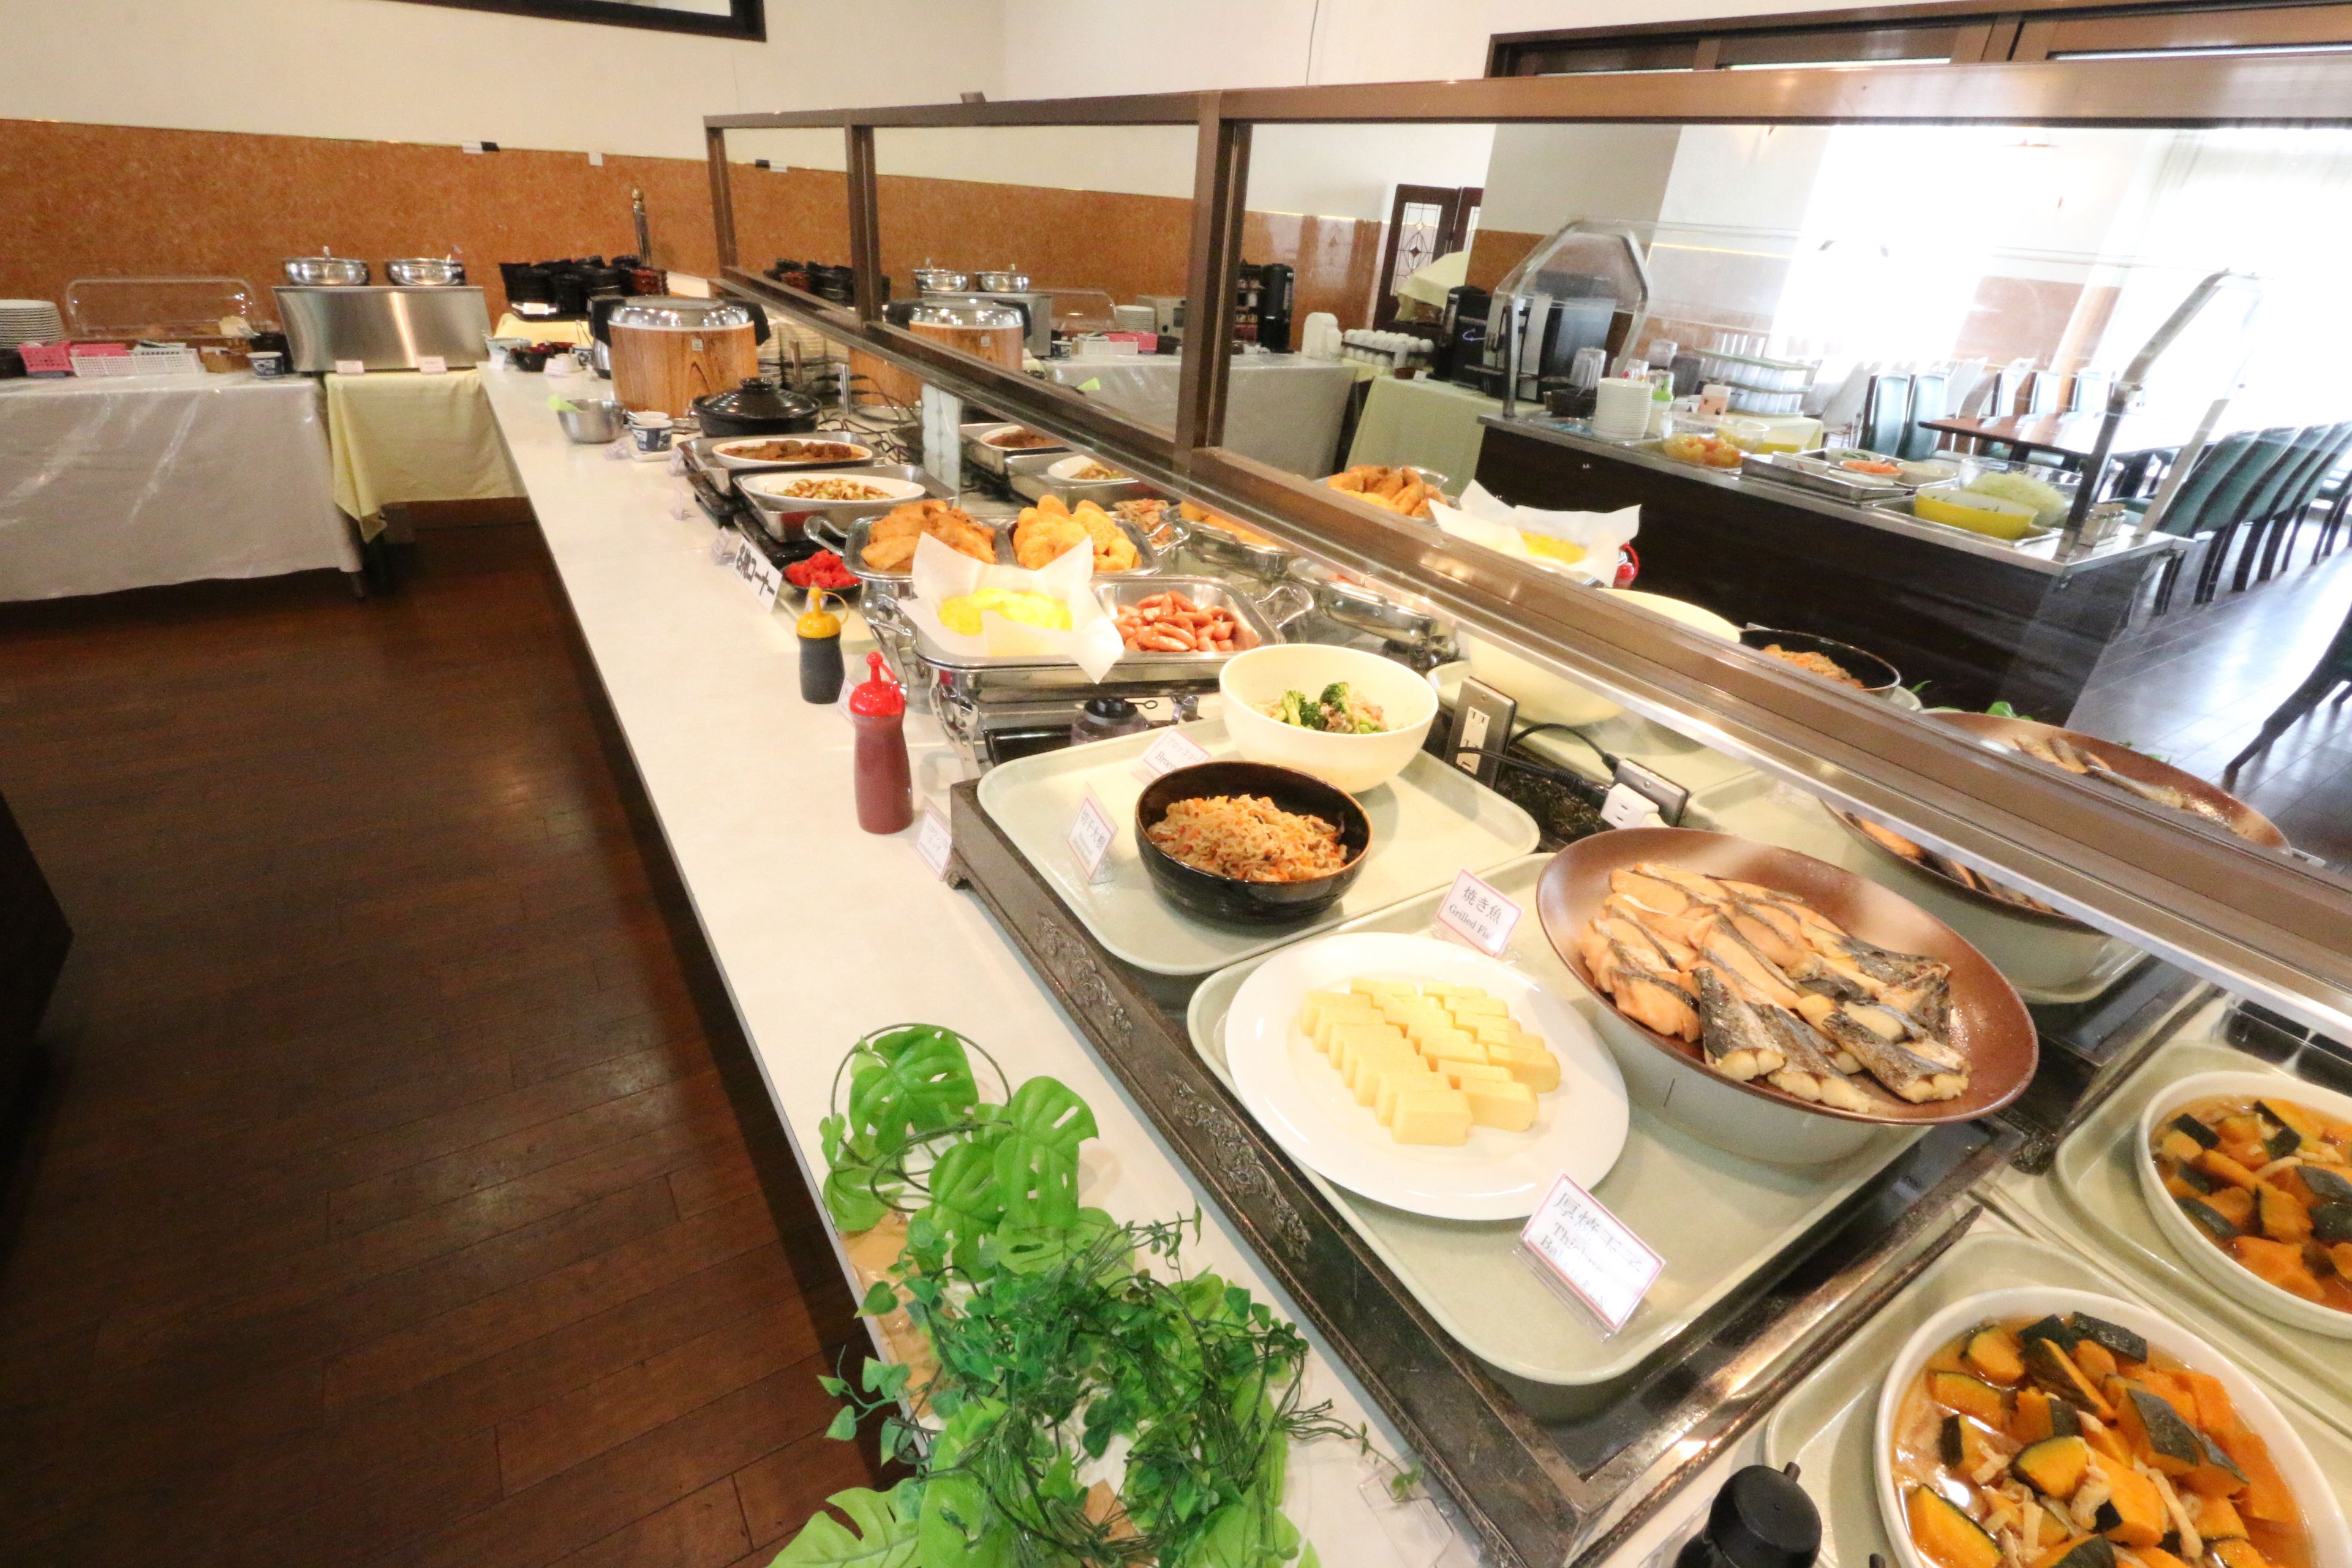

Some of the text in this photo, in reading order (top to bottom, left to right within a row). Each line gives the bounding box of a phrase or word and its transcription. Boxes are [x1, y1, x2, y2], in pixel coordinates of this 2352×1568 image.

[1155, 751, 1176, 771] Brocc
[1449, 903, 1494, 941] Grilled Fis
[1461, 886, 1502, 925] 焼き魚
